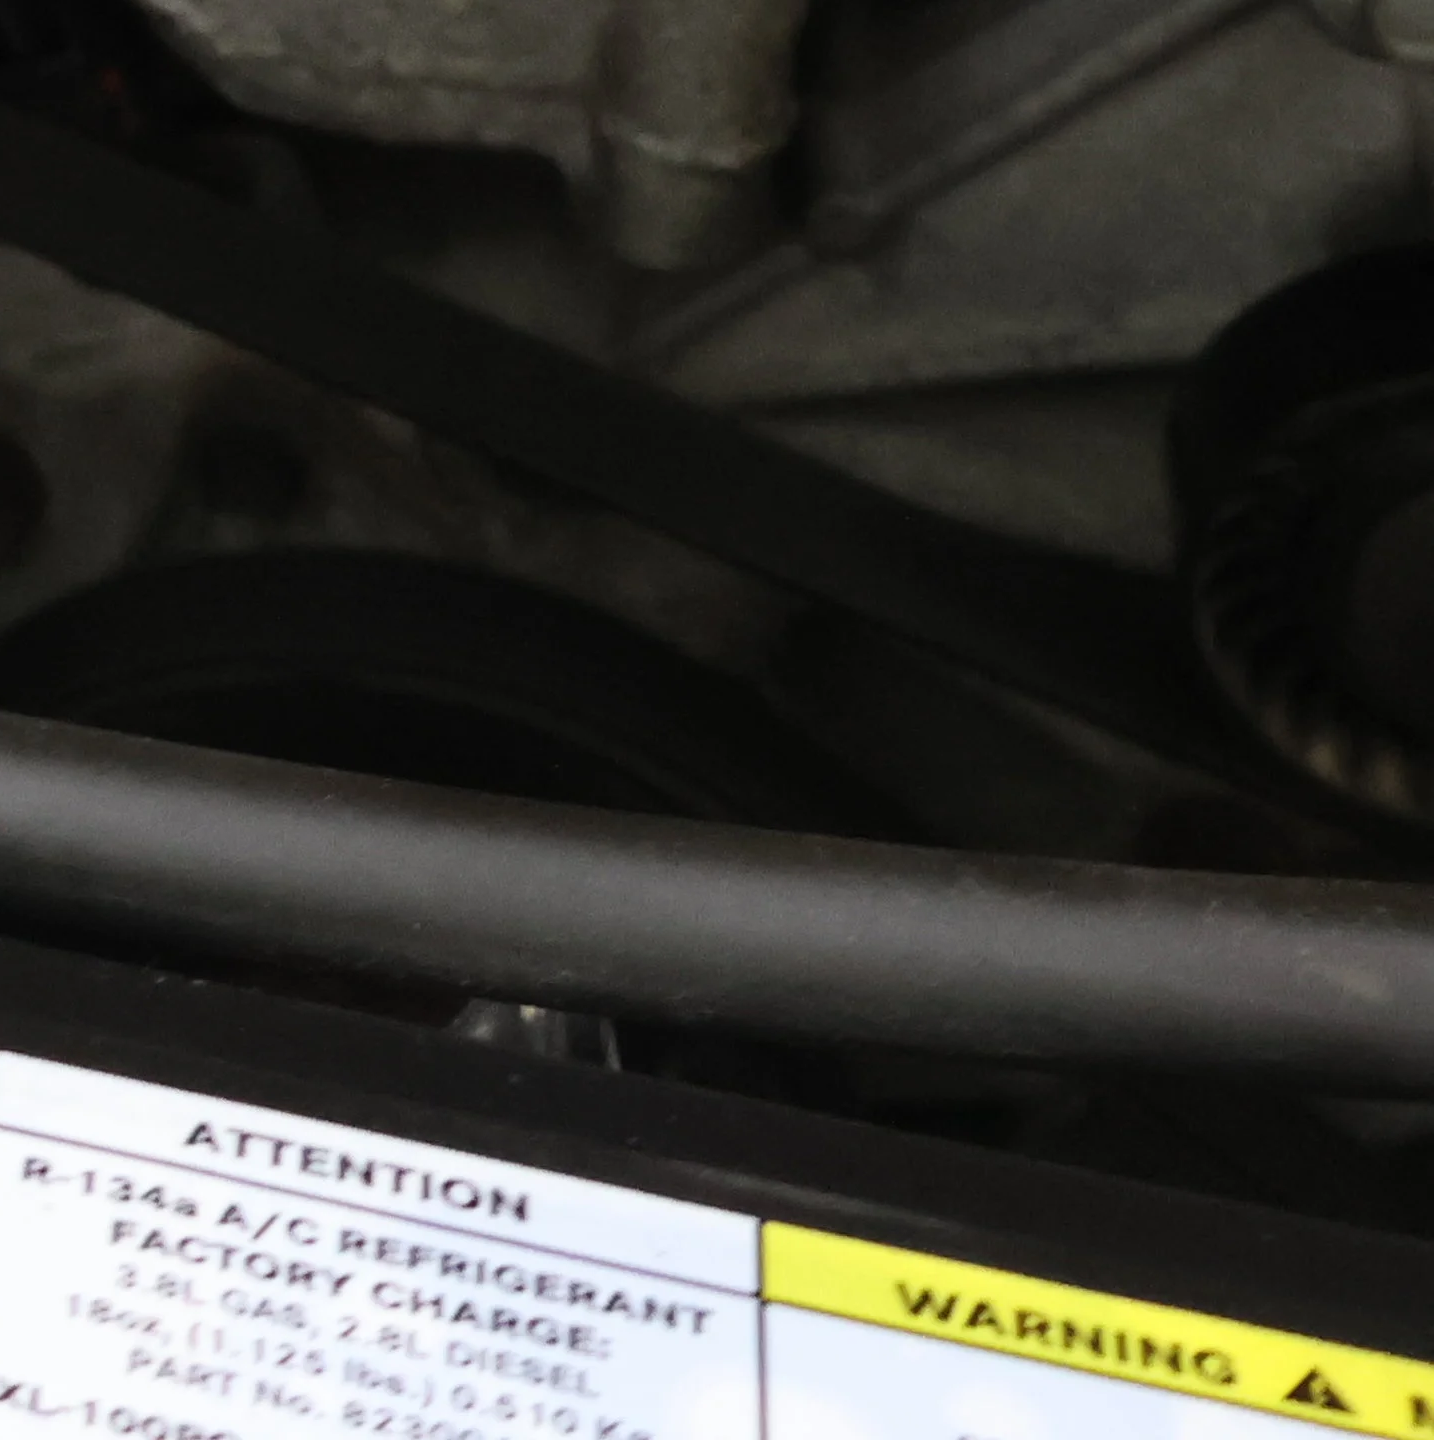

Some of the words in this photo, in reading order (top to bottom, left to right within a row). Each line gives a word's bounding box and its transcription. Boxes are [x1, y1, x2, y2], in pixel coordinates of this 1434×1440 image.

[184, 1120, 531, 1224] ATTENTION
[21, 1156, 198, 1219] R-134a
[217, 1203, 319, 1247] A/C
[339, 1229, 716, 1334] REFRIGERANT
[110, 1219, 354, 1297] FACTORY
[371, 1281, 612, 1359] CHARGE:
[117, 1263, 206, 1306] 3.8L
[220, 1288, 320, 1339] GAS,
[337, 1315, 427, 1359] 2.8L
[446, 1340, 600, 1398] DIESEL
[127, 1347, 238, 1397] PART
[253, 1379, 327, 1421] No.
[894, 1280, 1238, 1387] WARNING
